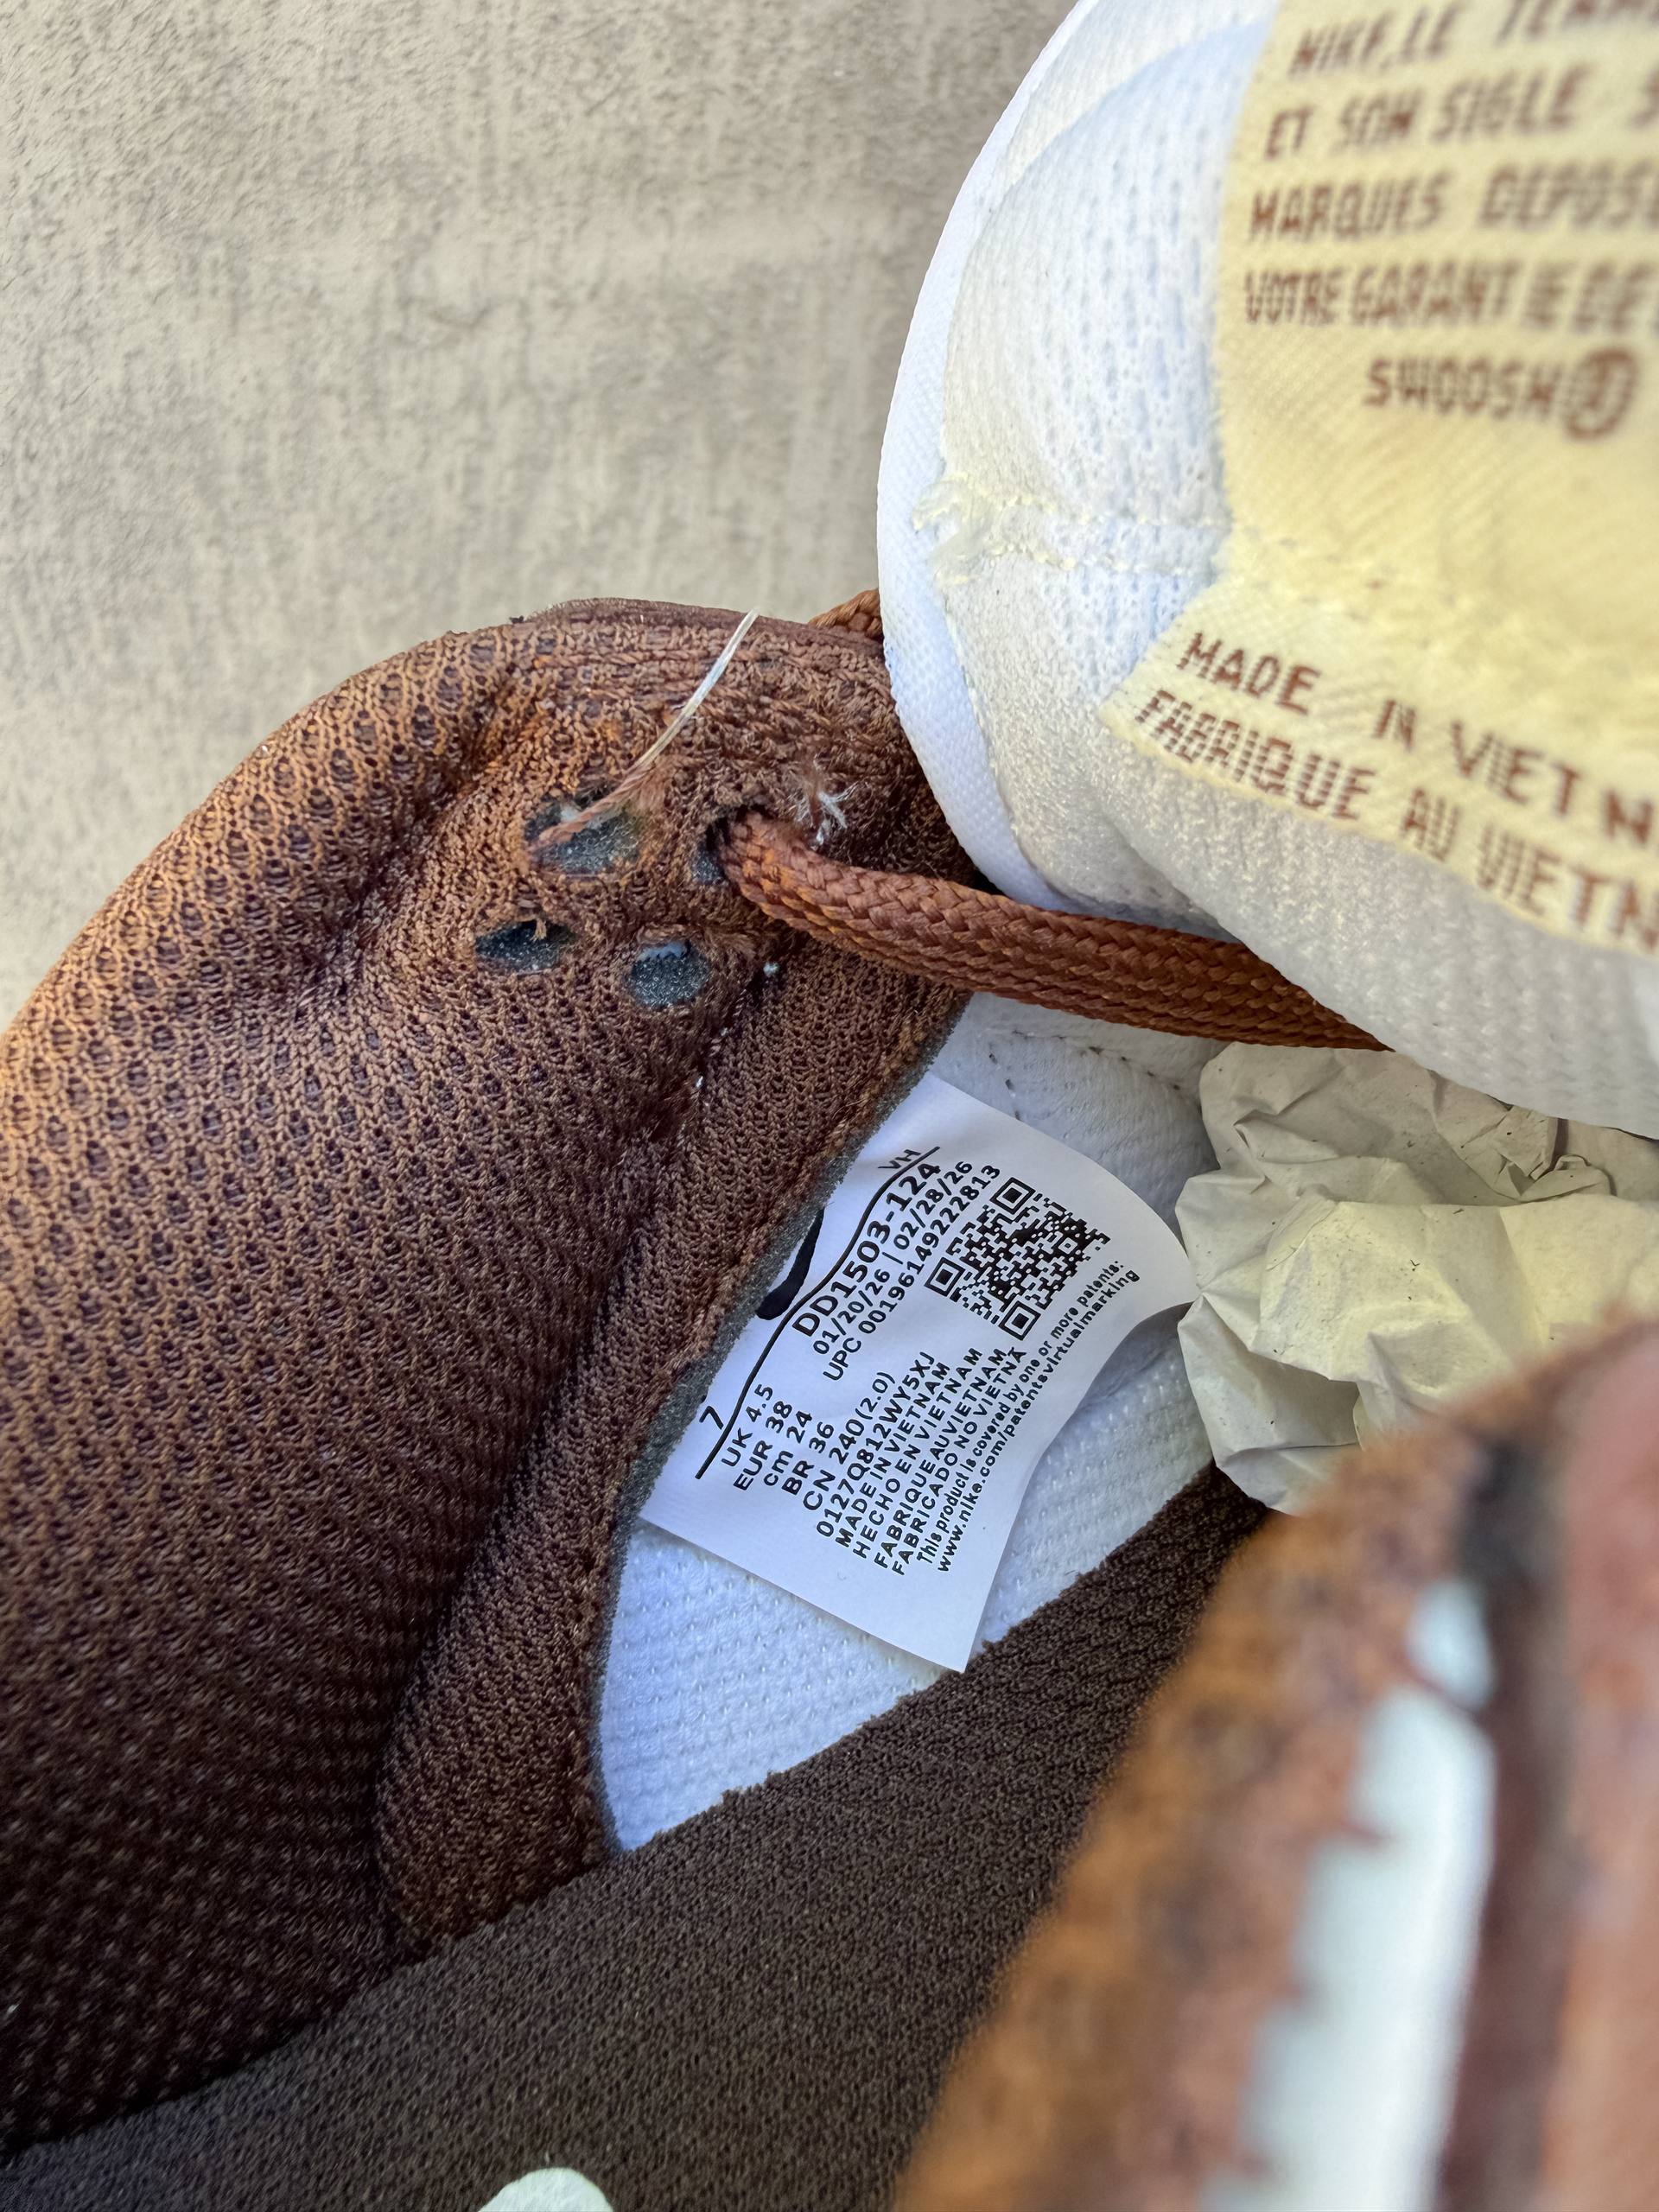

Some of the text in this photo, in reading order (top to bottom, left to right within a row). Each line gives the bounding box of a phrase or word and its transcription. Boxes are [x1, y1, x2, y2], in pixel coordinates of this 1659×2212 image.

[1264, 105, 1315, 159] ET
[1249, 169, 1453, 242] MARQUES
[1175, 631, 1322, 717] MADE
[1372, 700, 1417, 752] IN
[1135, 690, 1377, 821] FABRIQUE
[1400, 786, 1462, 862] AU
[791, 1163, 941, 1337] DD1503-124
[812, 1268, 891, 1355] 01/20/26
[893, 1161, 973, 1250] 02/28/26
[823, 1165, 1001, 1381] UPC 00196149222813
[699, 1405, 724, 1430] 7
[721, 1383, 773, 1467] UK 4.5
[733, 1400, 792, 1491] EUR 38
[763, 1410, 812, 1486] cm 24
[781, 1421, 834, 1496] BR 36
[803, 1371, 896, 1510] CN 240(2.0)
[816, 1351, 936, 1538] 0127Q812WY5XJ
[835, 1362, 950, 1548] MADE IN VIETNAM
[852, 1347, 983, 1559] HECHO EN VIETNAM
[916, 1531, 944, 1564] This
[936, 1471, 969, 1534] product
[973, 1402, 1011, 1458] covered
[1002, 1382, 1026, 1403] by
[1018, 1358, 1041, 1383] one
[1038, 1340, 1053, 1357] or
[1050, 1306, 1079, 1340] more
[1077, 1260, 1125, 1308] patents:
[874, 1459, 937, 1569] FABRIQUE
[891, 1452, 959, 1576] FABRICADO
[953, 1421, 978, 1450] NO
